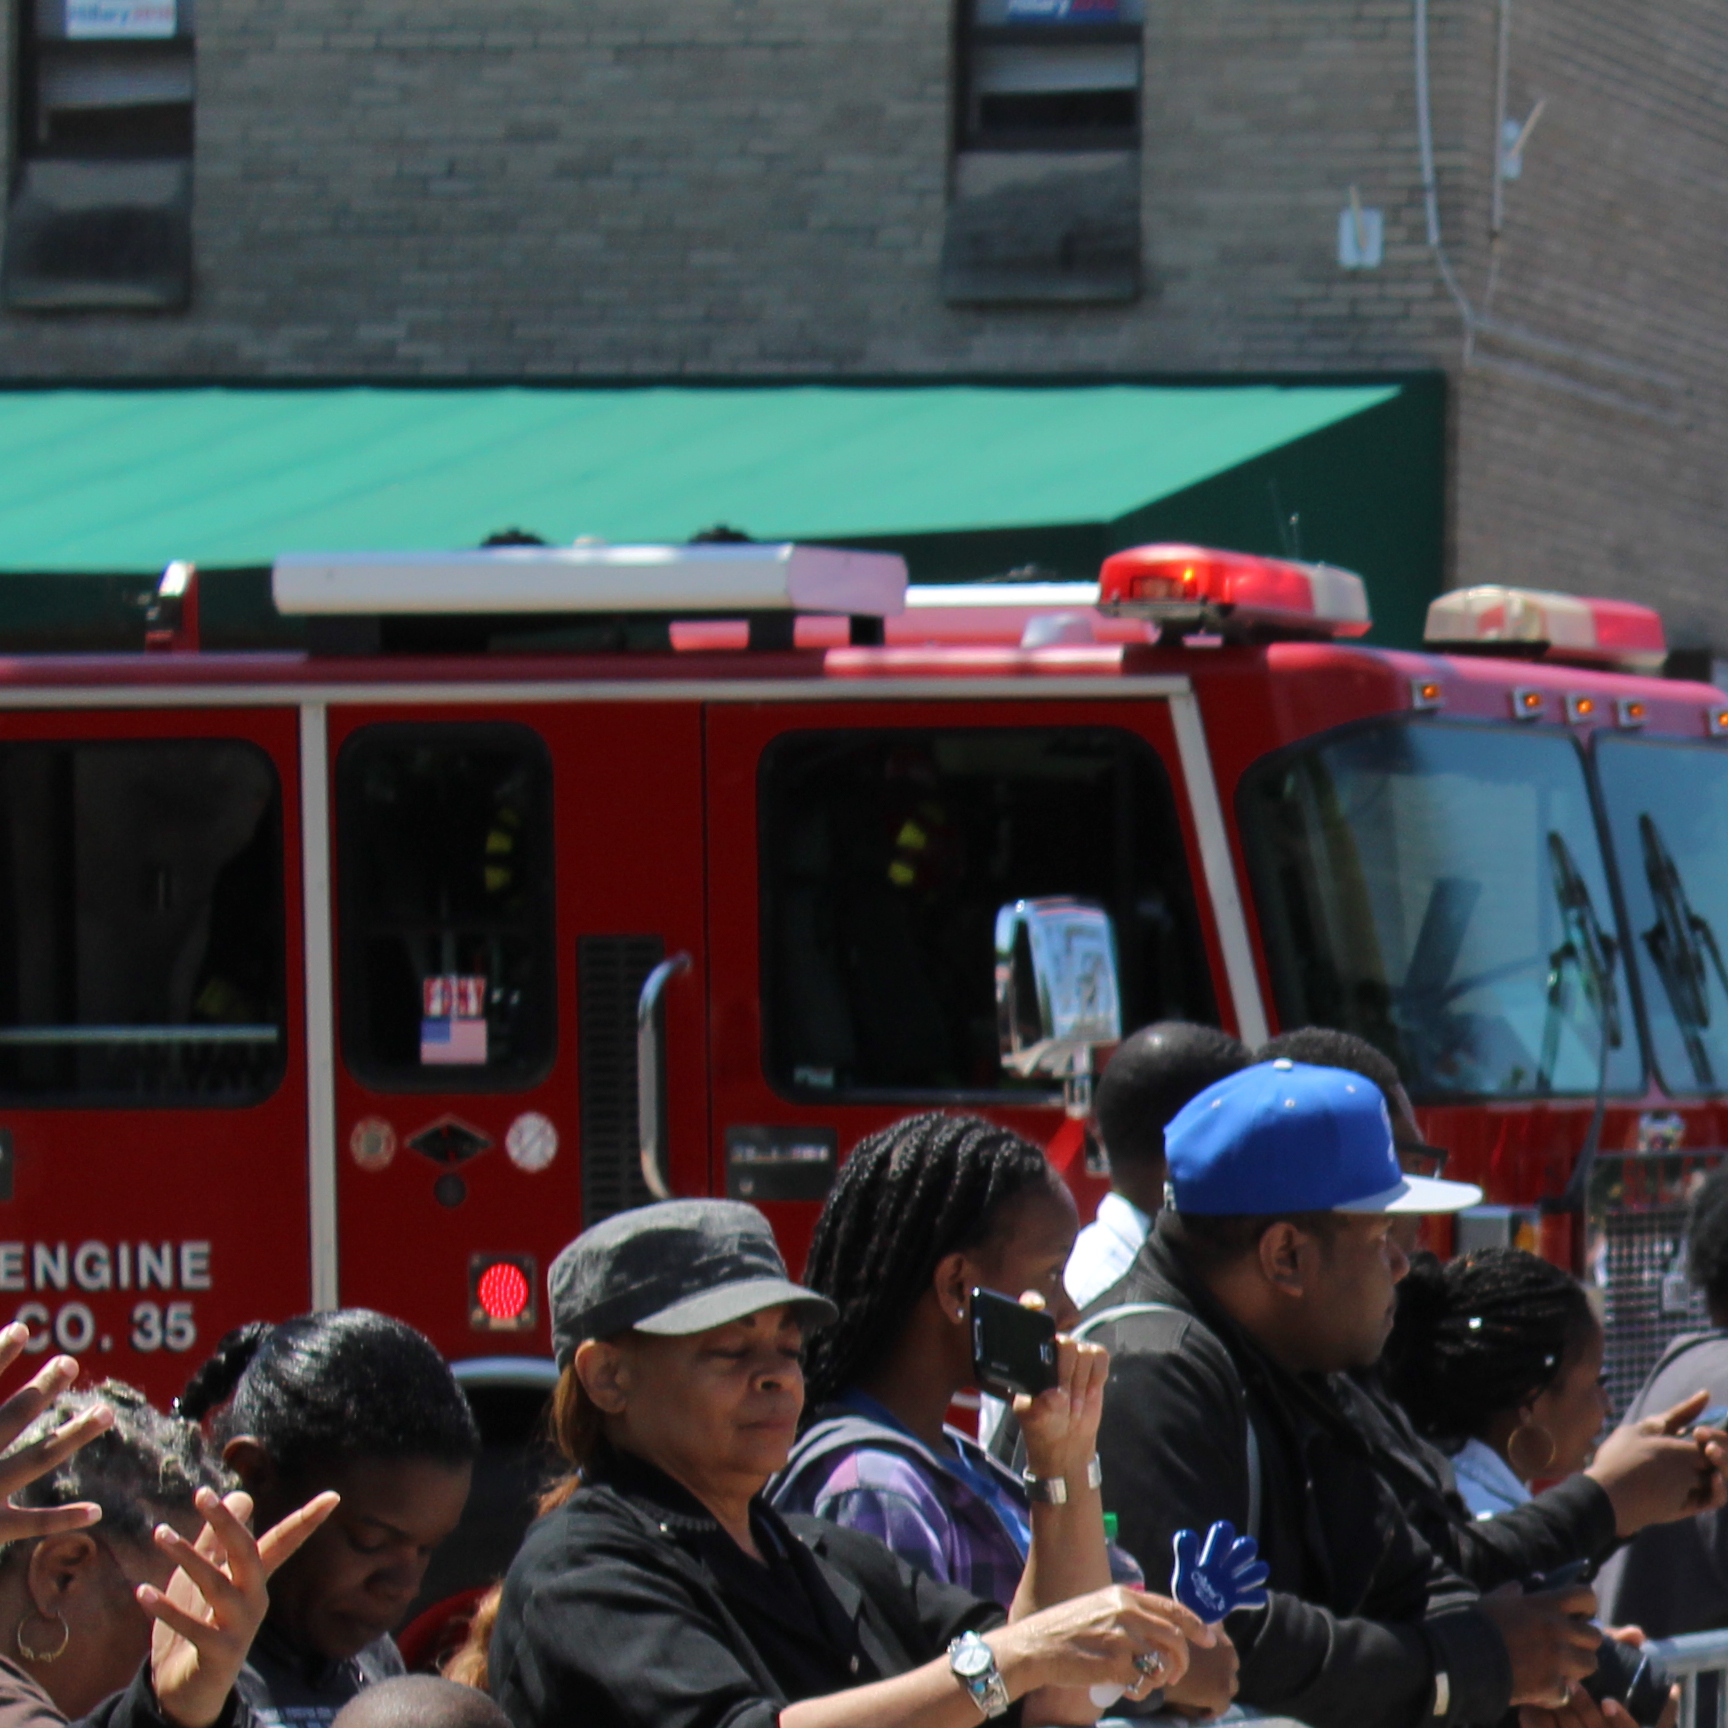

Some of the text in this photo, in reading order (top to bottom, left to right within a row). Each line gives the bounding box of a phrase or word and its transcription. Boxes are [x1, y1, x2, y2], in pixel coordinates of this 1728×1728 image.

[0, 1240, 211, 1291] ENGINE
[16, 1302, 196, 1354] CO. 35
